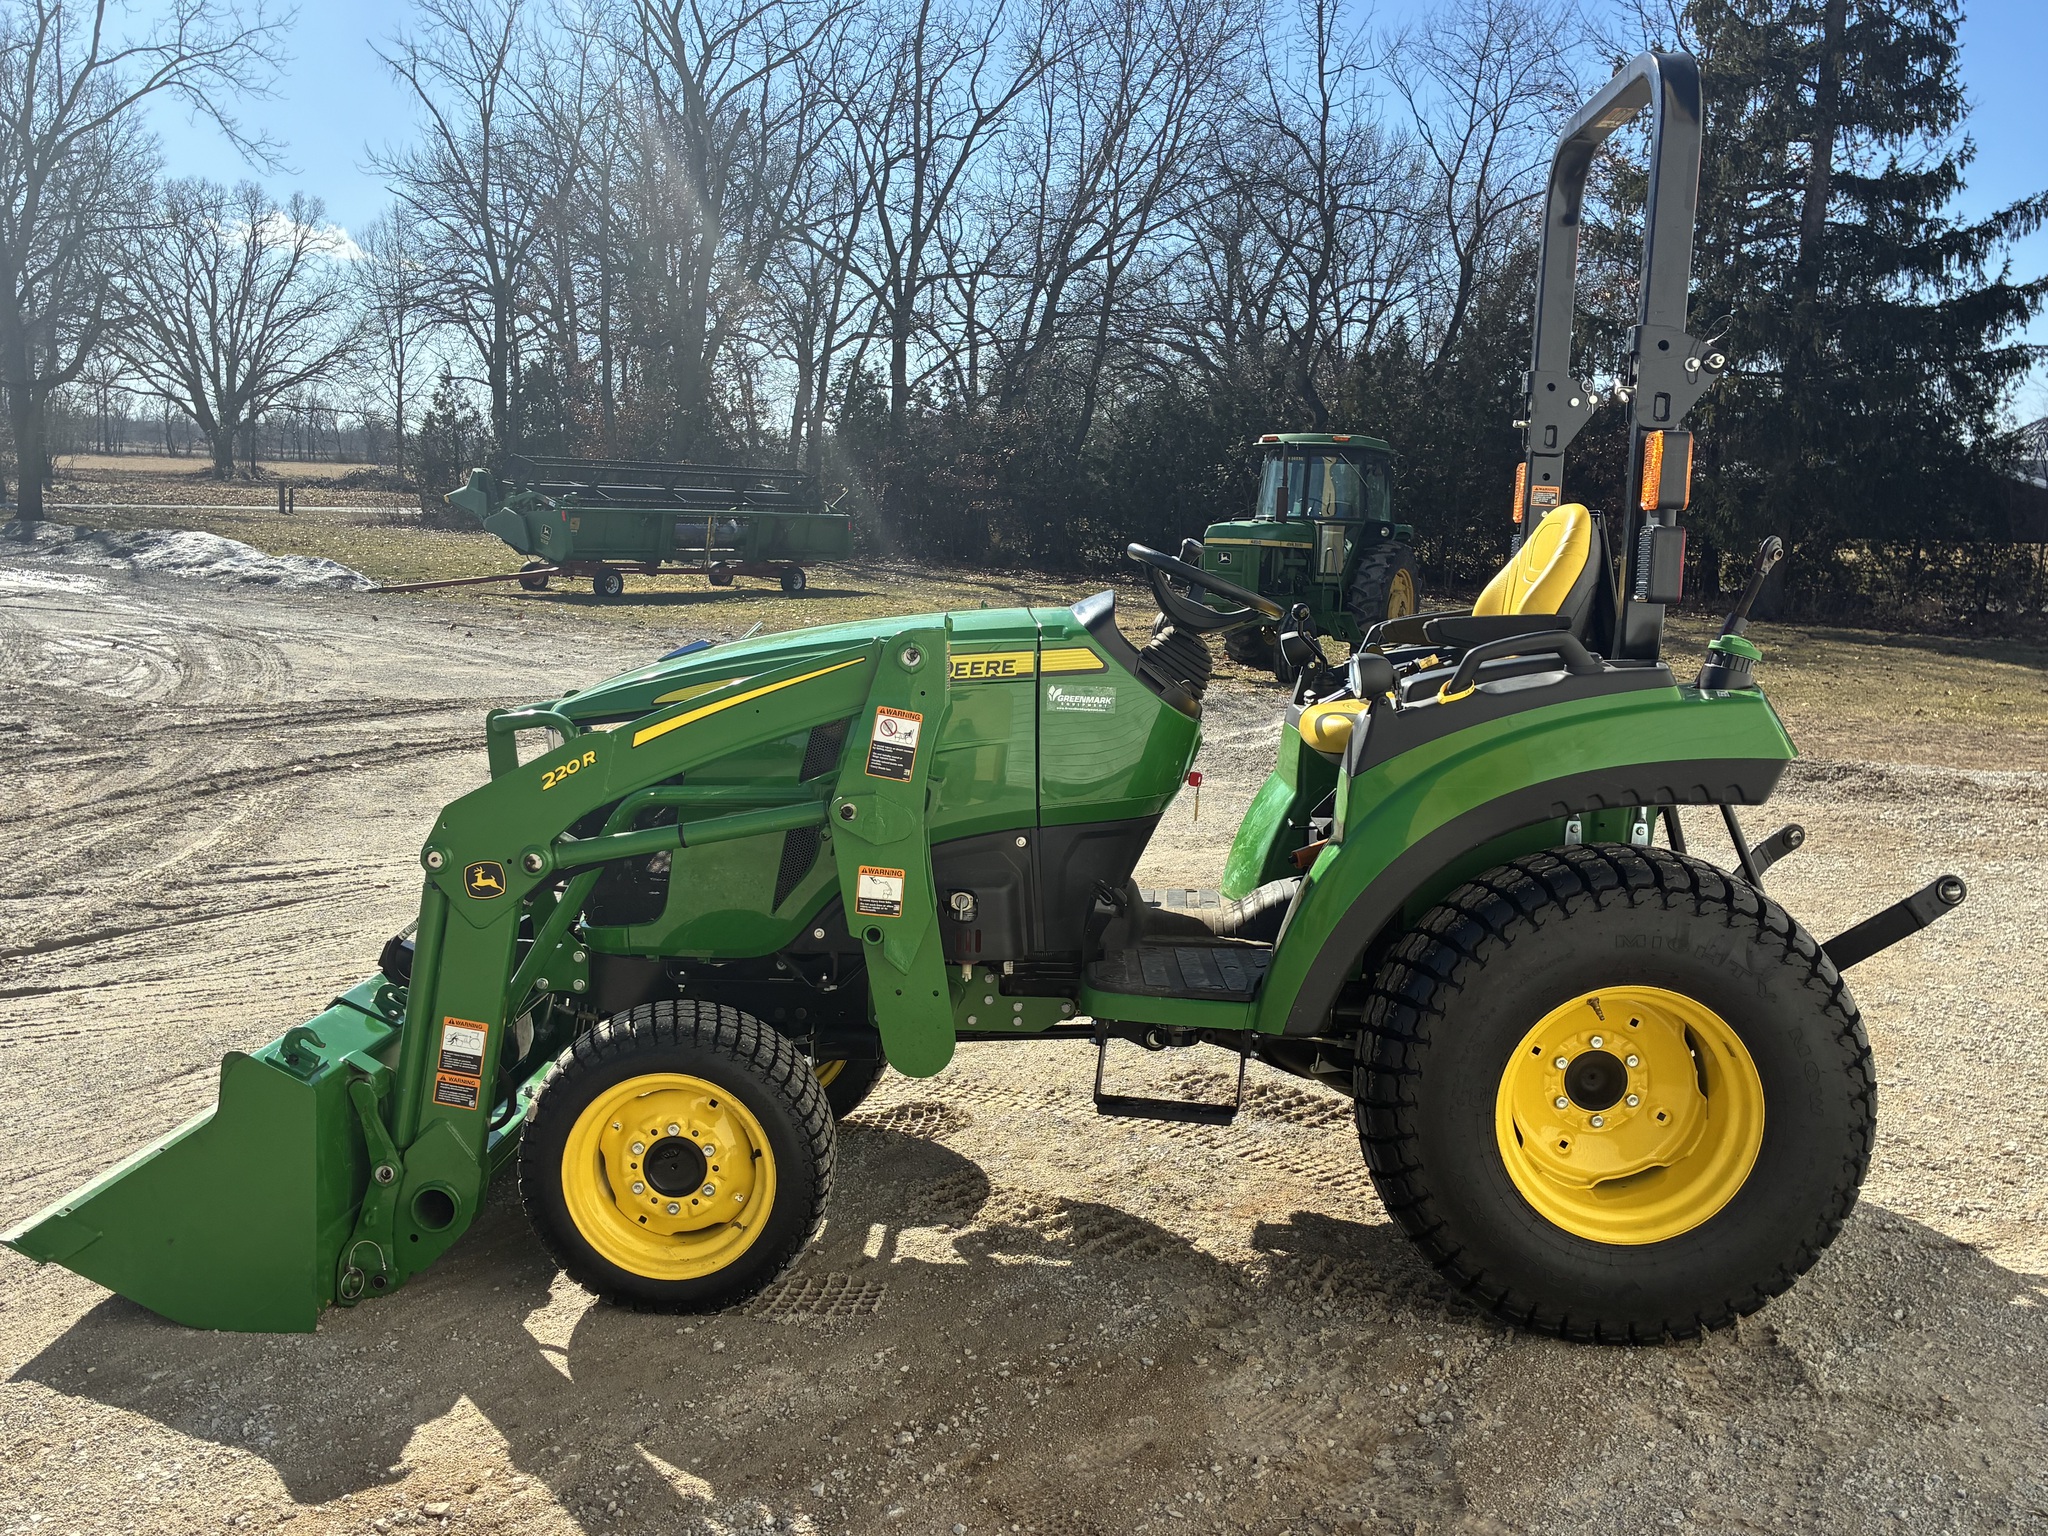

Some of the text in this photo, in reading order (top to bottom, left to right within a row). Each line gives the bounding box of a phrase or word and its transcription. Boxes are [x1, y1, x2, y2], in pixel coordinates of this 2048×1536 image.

[1057, 695, 1112, 704] GREENMARK
[886, 708, 921, 721] WARNING
[868, 867, 903, 877] WARNING
[455, 1020, 483, 1029] WARNING
[448, 1076, 475, 1085] WARNING
